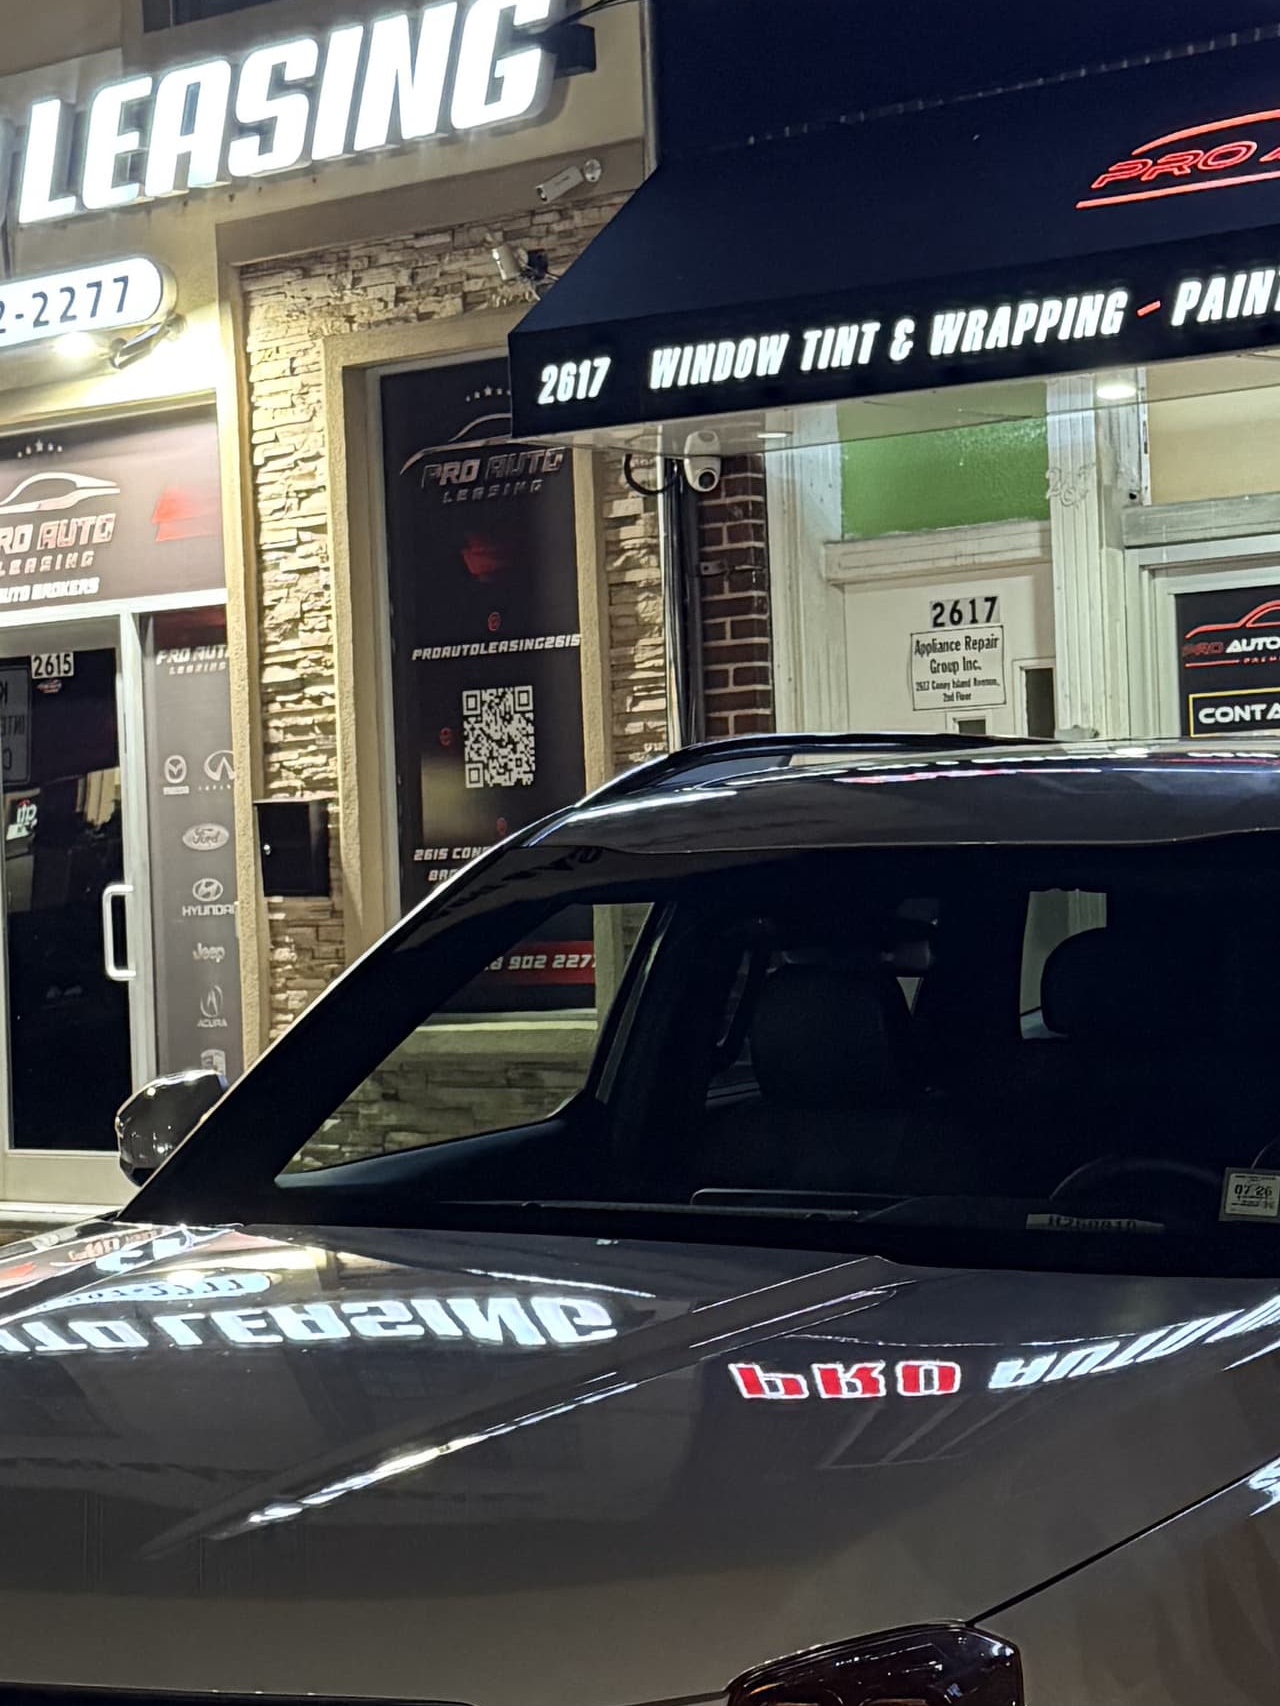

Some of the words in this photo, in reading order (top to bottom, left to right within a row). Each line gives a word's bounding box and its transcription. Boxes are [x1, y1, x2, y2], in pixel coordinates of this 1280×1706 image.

[1092, 141, 1258, 189] PRO
[536, 357, 610, 406] 2617
[648, 332, 790, 390] WINDOW
[800, 321, 881, 370] TINT
[889, 319, 915, 362] &
[929, 289, 1128, 357] WRAPPING
[421, 458, 480, 489] PRO
[484, 446, 566, 482] AUTO
[442, 479, 544, 504] LEASING
[37, 513, 117, 551] AUTO
[32, 577, 100, 603] BROKERS
[932, 596, 998, 627] 2617
[915, 638, 961, 657] Appliance
[965, 633, 999, 652] Repair
[33, 653, 72, 677] 2615
[930, 659, 959, 675] Group
[413, 847, 449, 861] 2615
[193, 943, 226, 962] Jeep
[508, 955, 547, 970] 902
[197, 1018, 228, 1028] ACURA
